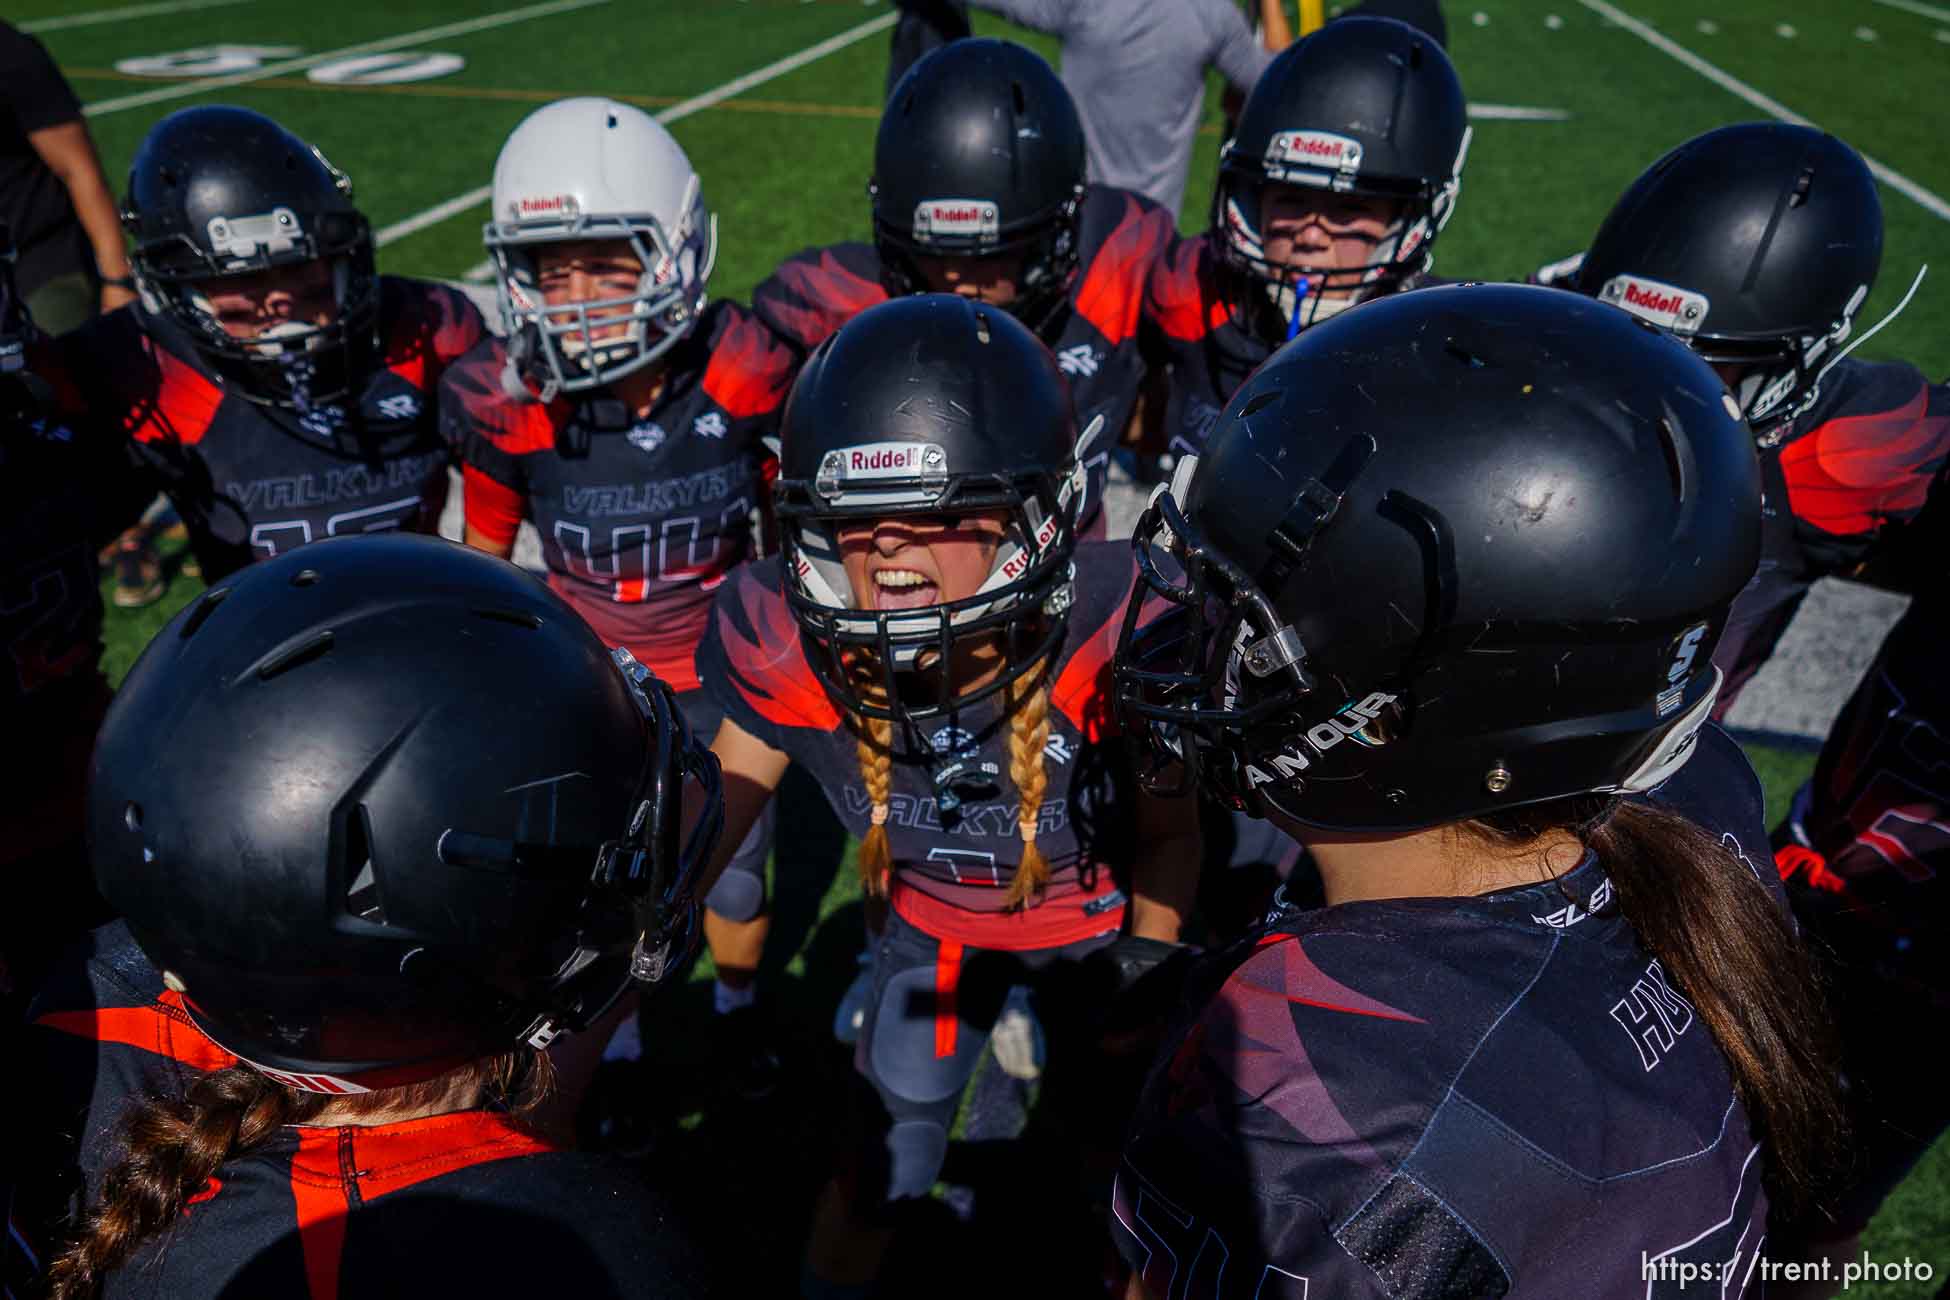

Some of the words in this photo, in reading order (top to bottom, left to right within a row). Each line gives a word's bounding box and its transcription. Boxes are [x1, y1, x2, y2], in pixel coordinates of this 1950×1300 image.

[1291, 136, 1343, 157] Riddell
[933, 208, 978, 222] Riddell
[1624, 283, 1684, 315] Riddell
[851, 447, 919, 470] Riddell
